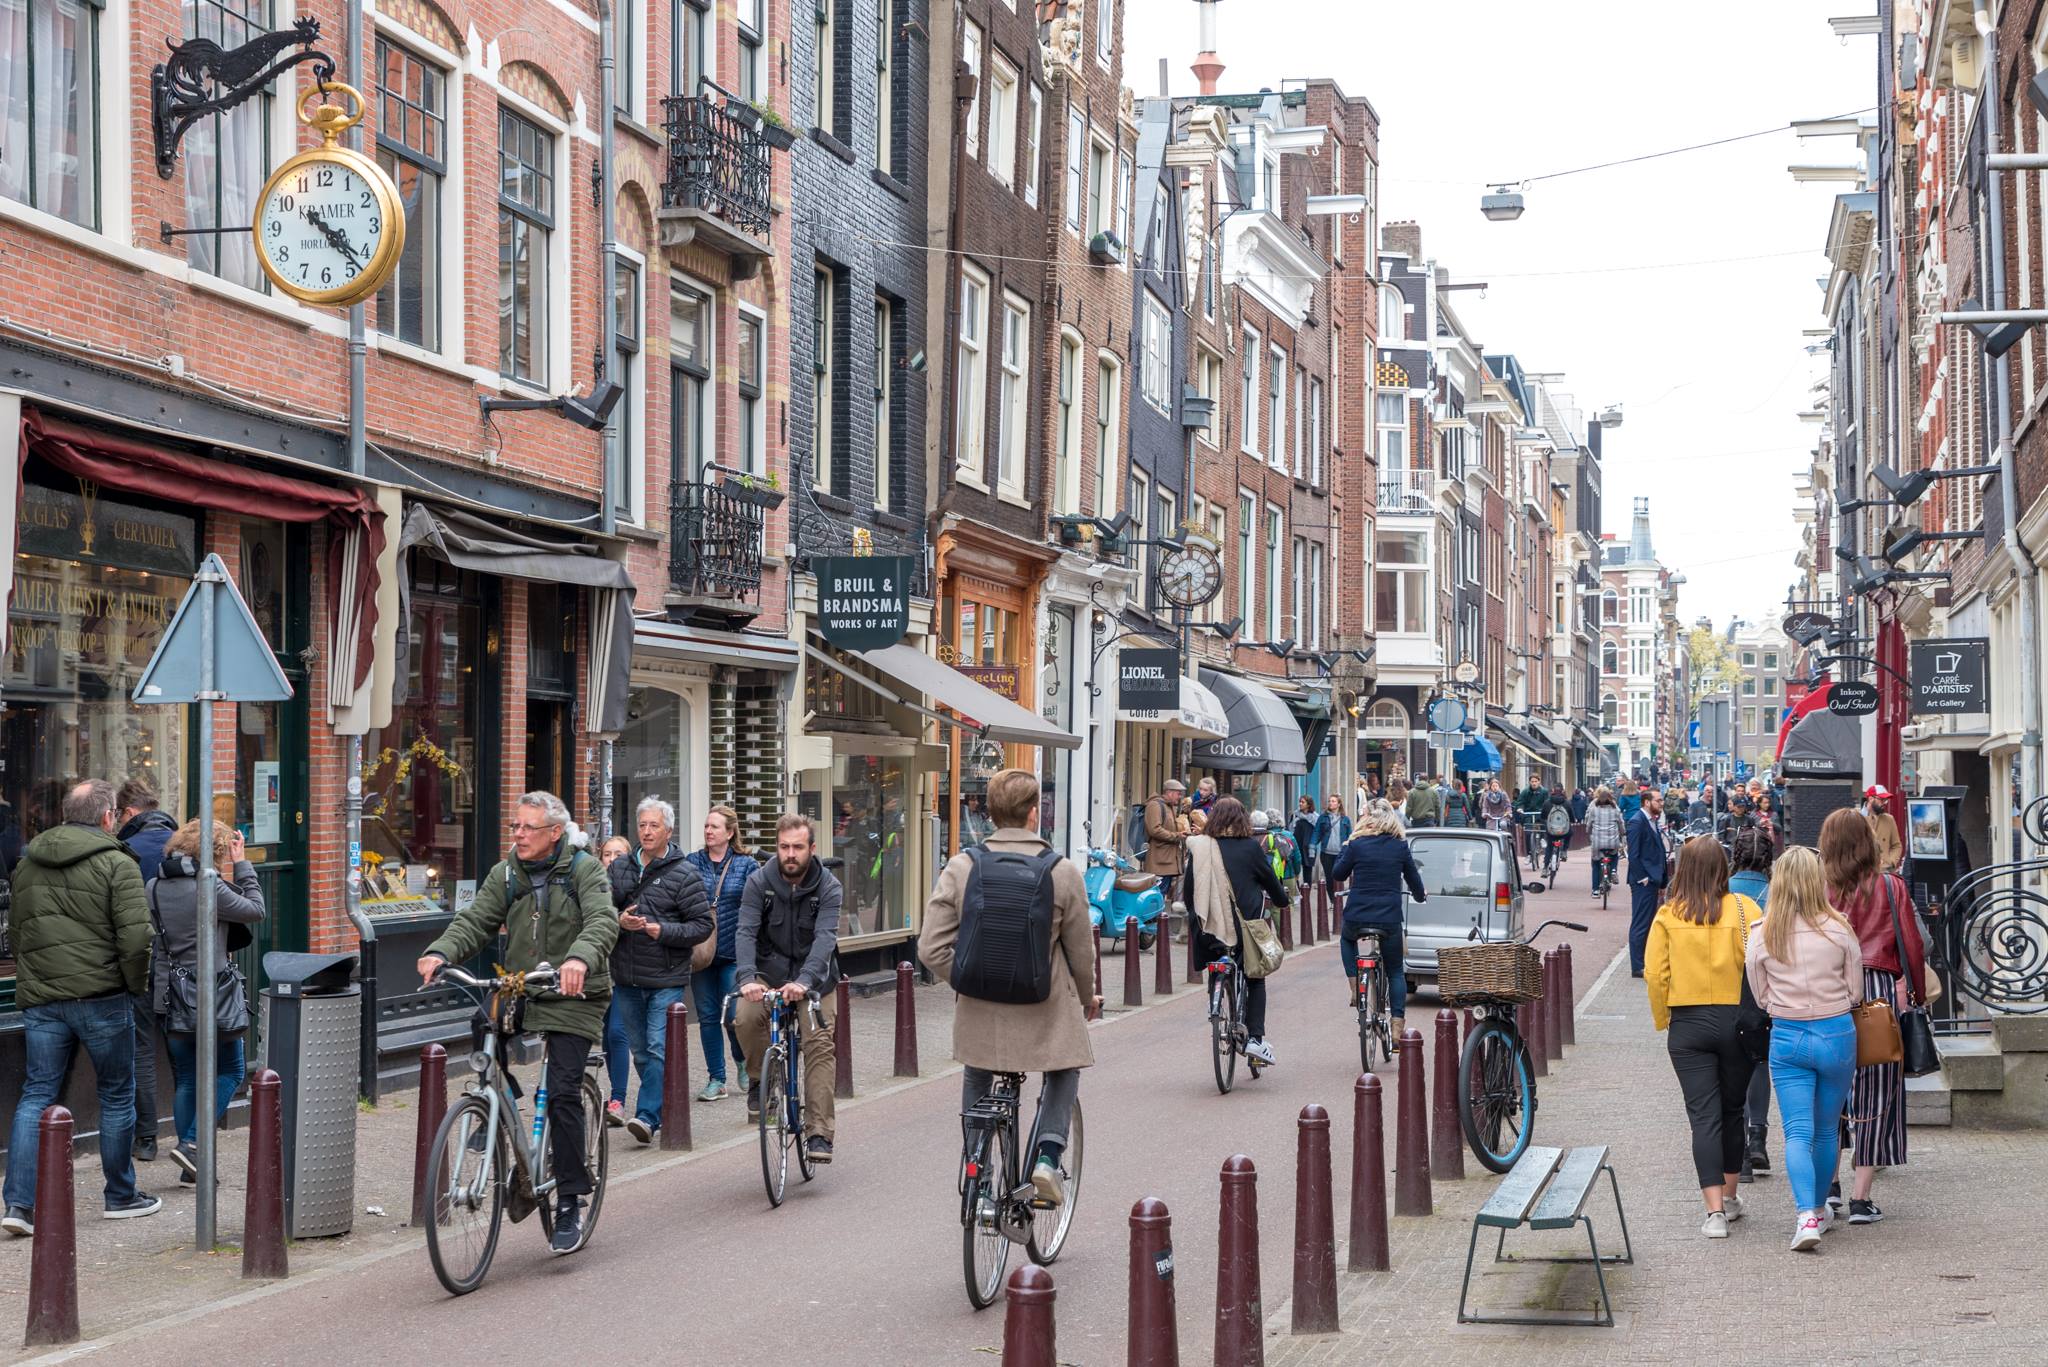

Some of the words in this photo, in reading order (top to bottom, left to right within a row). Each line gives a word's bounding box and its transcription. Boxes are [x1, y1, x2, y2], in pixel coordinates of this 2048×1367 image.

[298, 177, 309, 193] 11
[316, 170, 333, 187] 12
[344, 175, 351, 191] 1
[279, 195, 294, 212] 10
[361, 192, 371, 208] 2
[271, 221, 281, 237] 9
[369, 217, 379, 234] 3
[279, 246, 289, 262] 8
[360, 243, 370, 259] 4
[300, 263, 309, 279] 7
[321, 267, 331, 283] 6
[345, 262, 356, 278] 5
[34, 505, 70, 529] GLAS
[113, 519, 177, 549] CERAMIEK
[834, 578, 875, 593] BRUIL
[883, 578, 893, 592] &
[58, 583, 103, 617] KUNST
[105, 591, 117, 619] &
[119, 592, 169, 624] ANTIEK
[823, 598, 902, 614] BRANDSMA
[830, 619, 862, 629] WORKS
[865, 619, 877, 629] OF
[880, 619, 898, 629] ART
[55, 630, 96, 653] VERKOOP
[1121, 666, 1165, 679] LIONEL
[1932, 674, 1960, 685] CARRÉ
[1121, 679, 1177, 692] GALLERY
[1840, 688, 1867, 698] Inkoop
[1829, 699, 1851, 710] Oud
[1851, 699, 1877, 710] Goud
[1940, 700, 1966, 708] Gallery
[1210, 741, 1262, 757] clocks
[1788, 760, 1812, 769] Marij
[1812, 760, 1834, 769] Kaak
